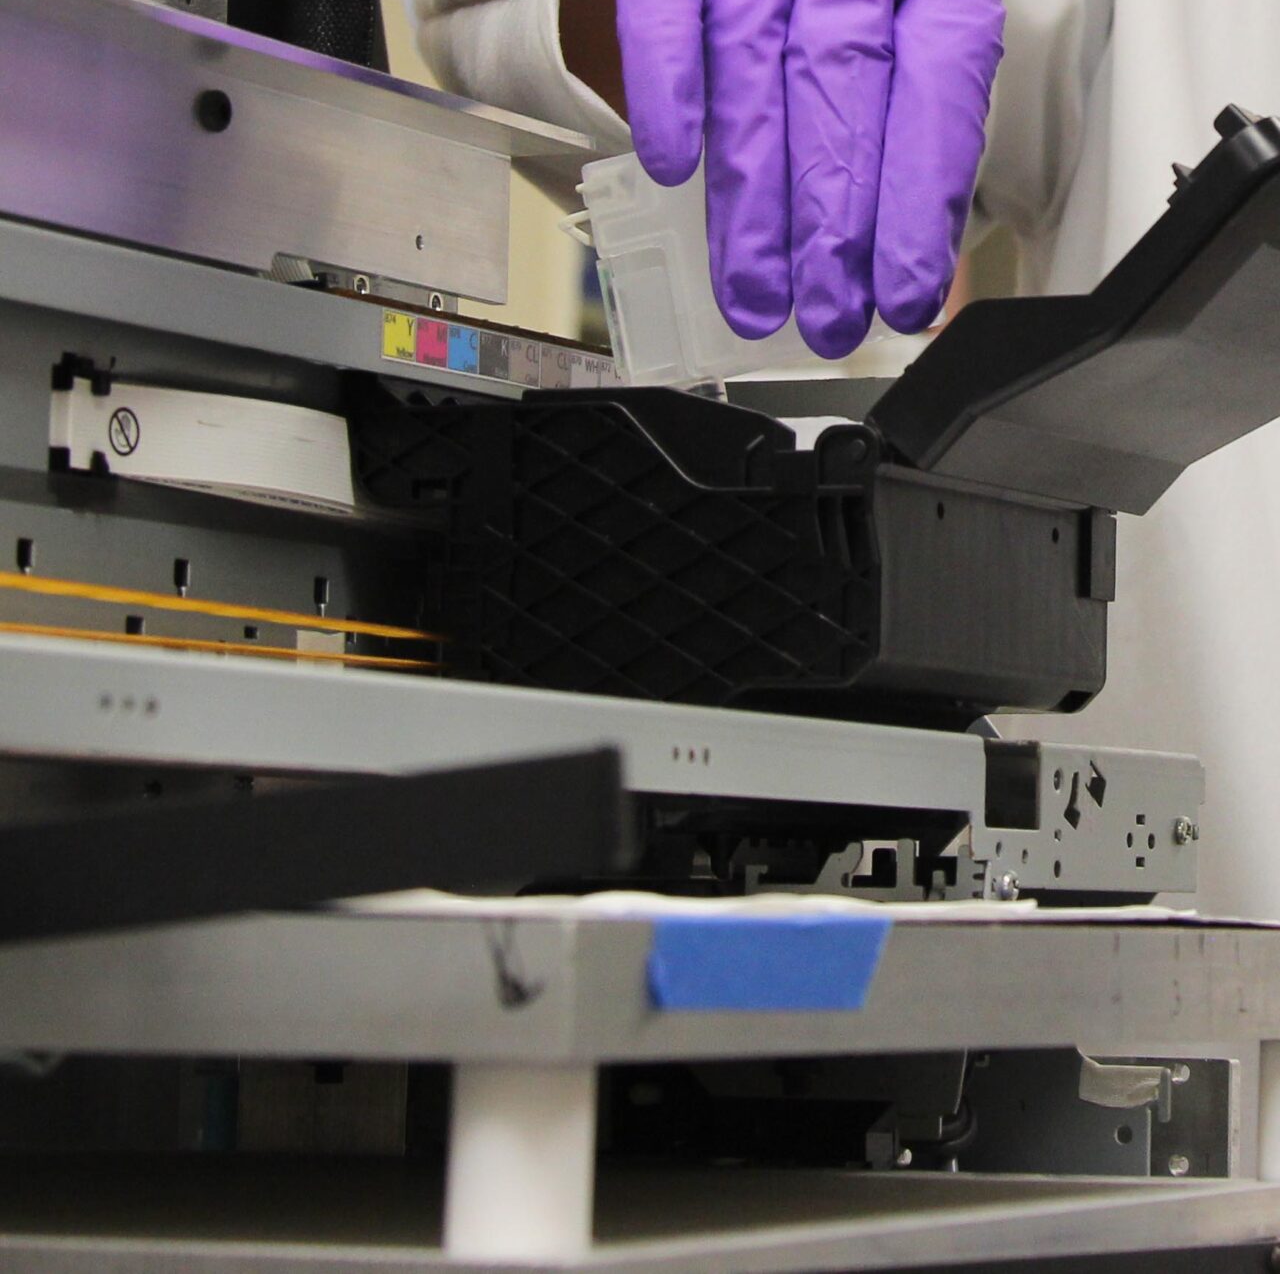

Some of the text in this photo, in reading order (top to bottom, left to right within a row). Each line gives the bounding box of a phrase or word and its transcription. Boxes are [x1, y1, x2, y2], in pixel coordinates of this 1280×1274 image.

[406, 319, 415, 336] Y
[469, 332, 477, 350] C
[501, 338, 508, 357] K
[526, 344, 539, 364] CL
[584, 357, 599, 375] WH
